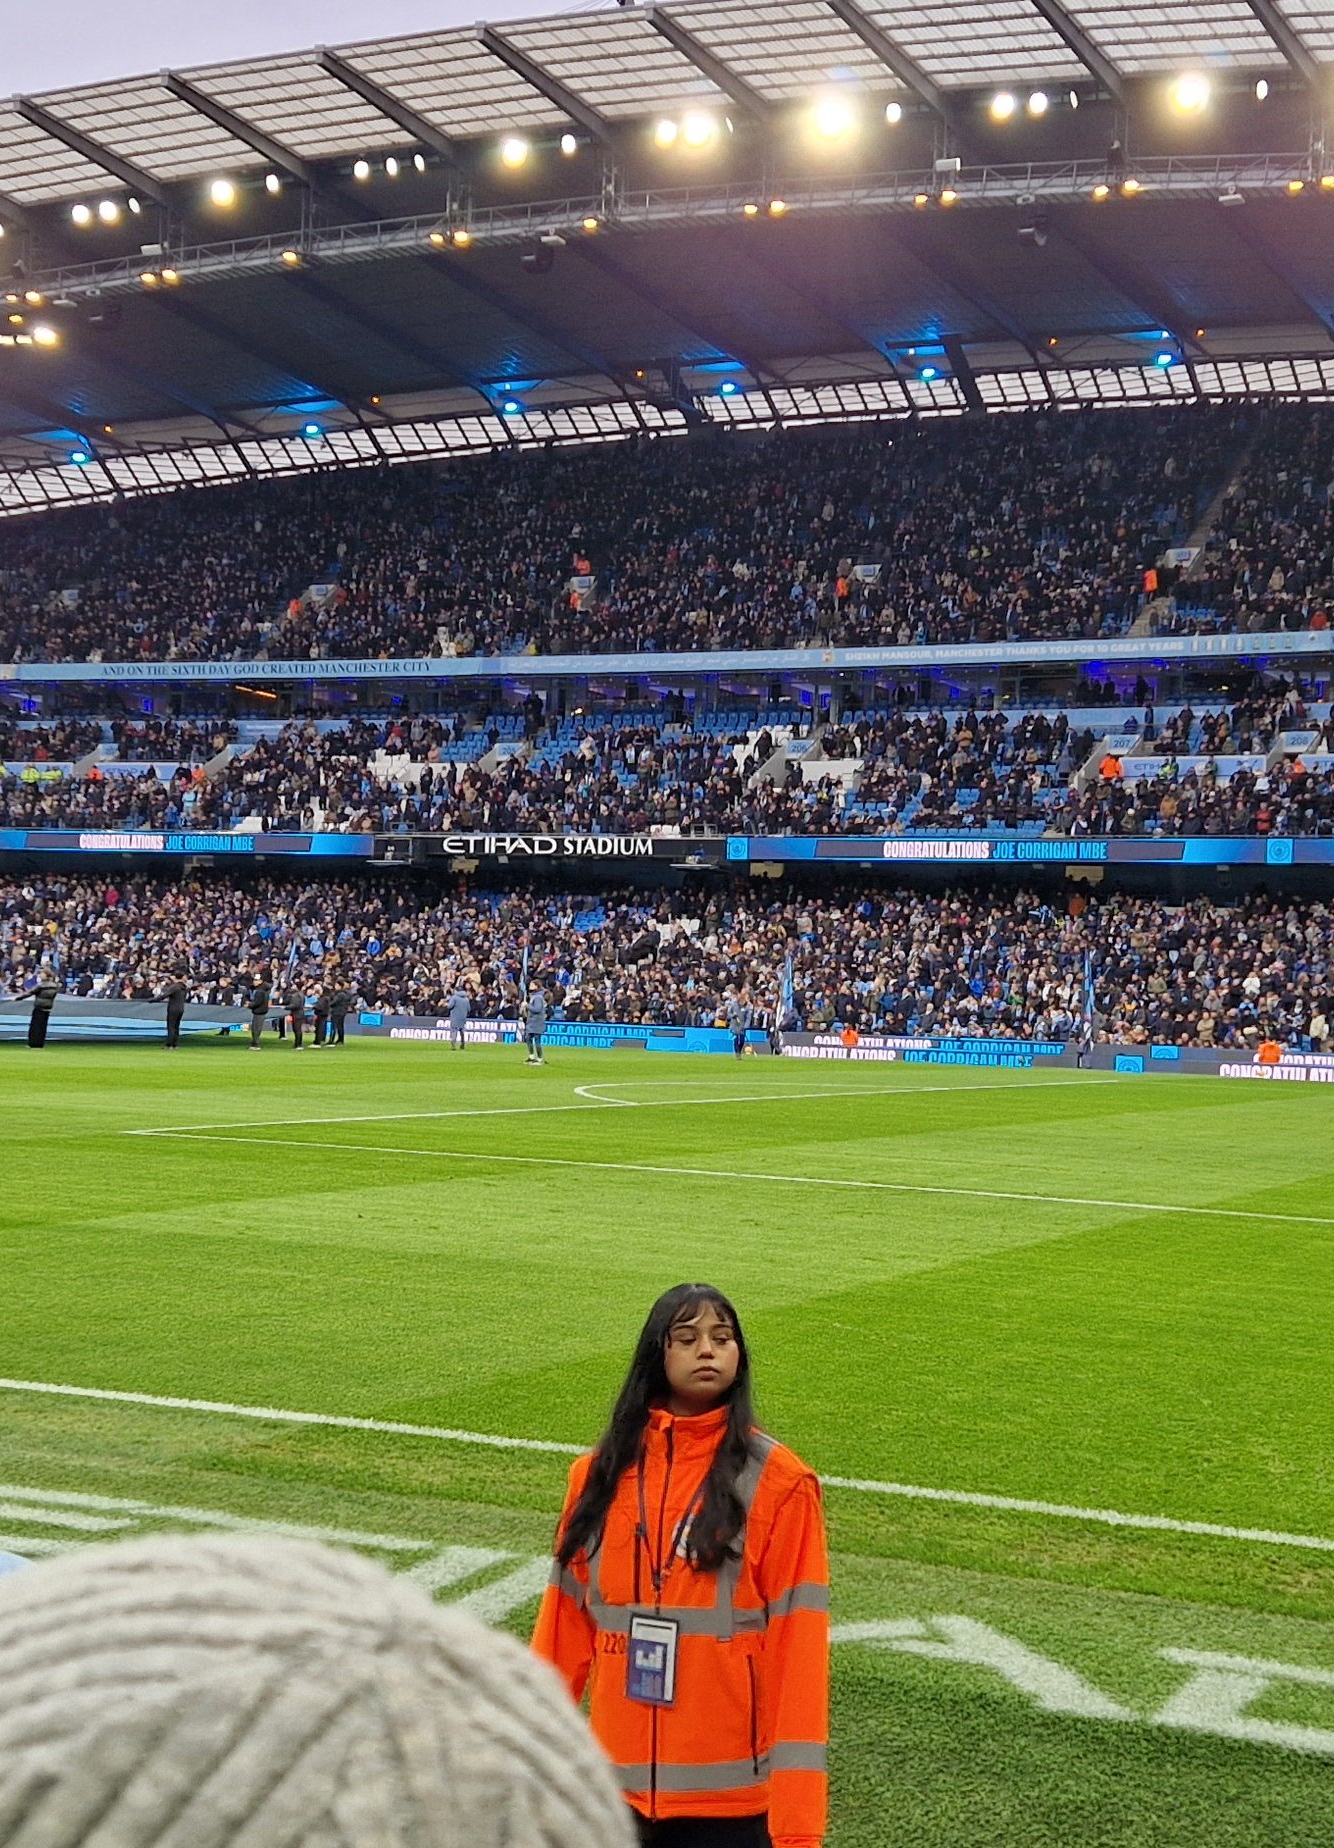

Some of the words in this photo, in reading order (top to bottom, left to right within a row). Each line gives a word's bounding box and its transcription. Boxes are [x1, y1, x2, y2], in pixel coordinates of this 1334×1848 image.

[845, 652, 880, 661] SHEIKH
[936, 648, 1002, 658] MANCHESTER
[1006, 646, 1047, 656] THANKS
[1050, 645, 1070, 654] YOU
[1073, 644, 1095, 654] FOR
[1098, 644, 1108, 652] 10
[1111, 643, 1146, 652] GREAT
[1149, 641, 1184, 651] YEARS
[101, 666, 124, 676] AND
[127, 666, 144, 676] ON
[147, 666, 168, 675] THE
[171, 665, 207, 675] SIXTH
[208, 665, 231, 675] DAY
[234, 664, 259, 674] GOD
[262, 663, 316, 674] CREATED
[319, 662, 400, 673] MANCHESTER
[403, 661, 432, 672] CITY
[1113, 738, 1131, 748] 207
[1290, 737, 1308, 746] 208
[80, 834, 163, 850] CONGRATULATIONS
[166, 836, 184, 850] JOE
[184, 836, 231, 851] CORRIGAN
[232, 836, 254, 851] MBE
[443, 836, 557, 855] ETIHAD
[563, 837, 653, 856] STADIUM
[883, 841, 989, 859] CONGRATULATIONS
[992, 842, 1015, 859] JOE
[1016, 842, 1078, 859] CORRIGAN
[1079, 842, 1108, 859] MBE
[390, 1027, 498, 1043] CONGRATUATIONS
[814, 1035, 932, 1049] CONATULATIONS
[784, 1046, 896, 1061] ONGRATULATIONS
